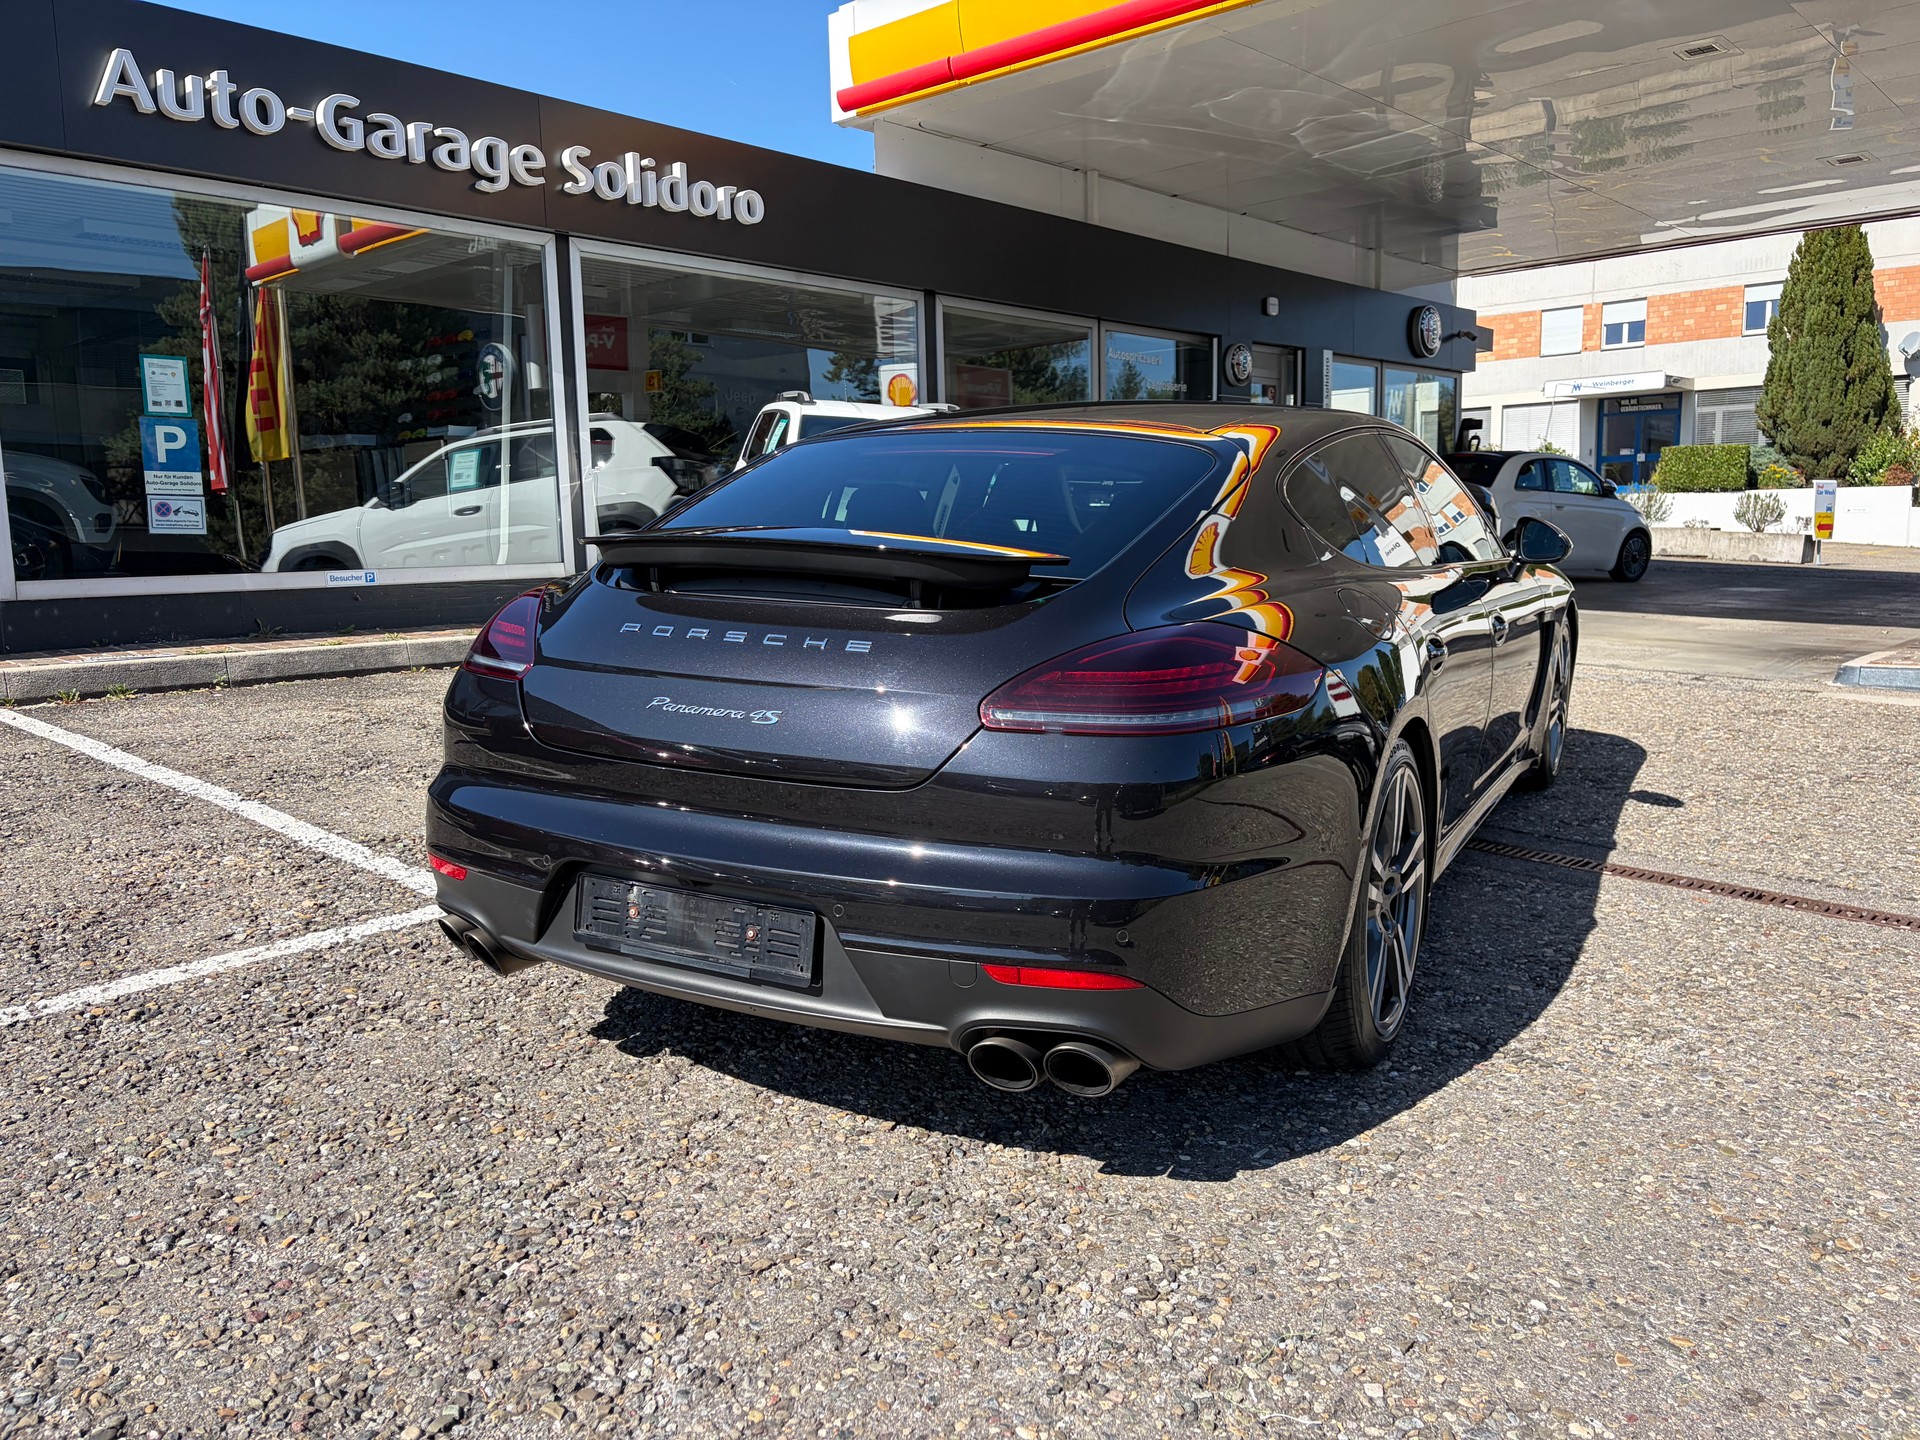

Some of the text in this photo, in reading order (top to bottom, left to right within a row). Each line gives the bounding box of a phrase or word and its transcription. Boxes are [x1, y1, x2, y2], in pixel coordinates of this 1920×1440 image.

[94, 47, 765, 226] Auto-Garage Solidoro
[724, 387, 756, 406] Jeep
[1592, 378, 1635, 389] Weinberger
[154, 425, 187, 463] P
[329, 574, 363, 582] Besucher
[619, 622, 873, 653] PORSCHE
[646, 696, 783, 726] Panamera 4S
